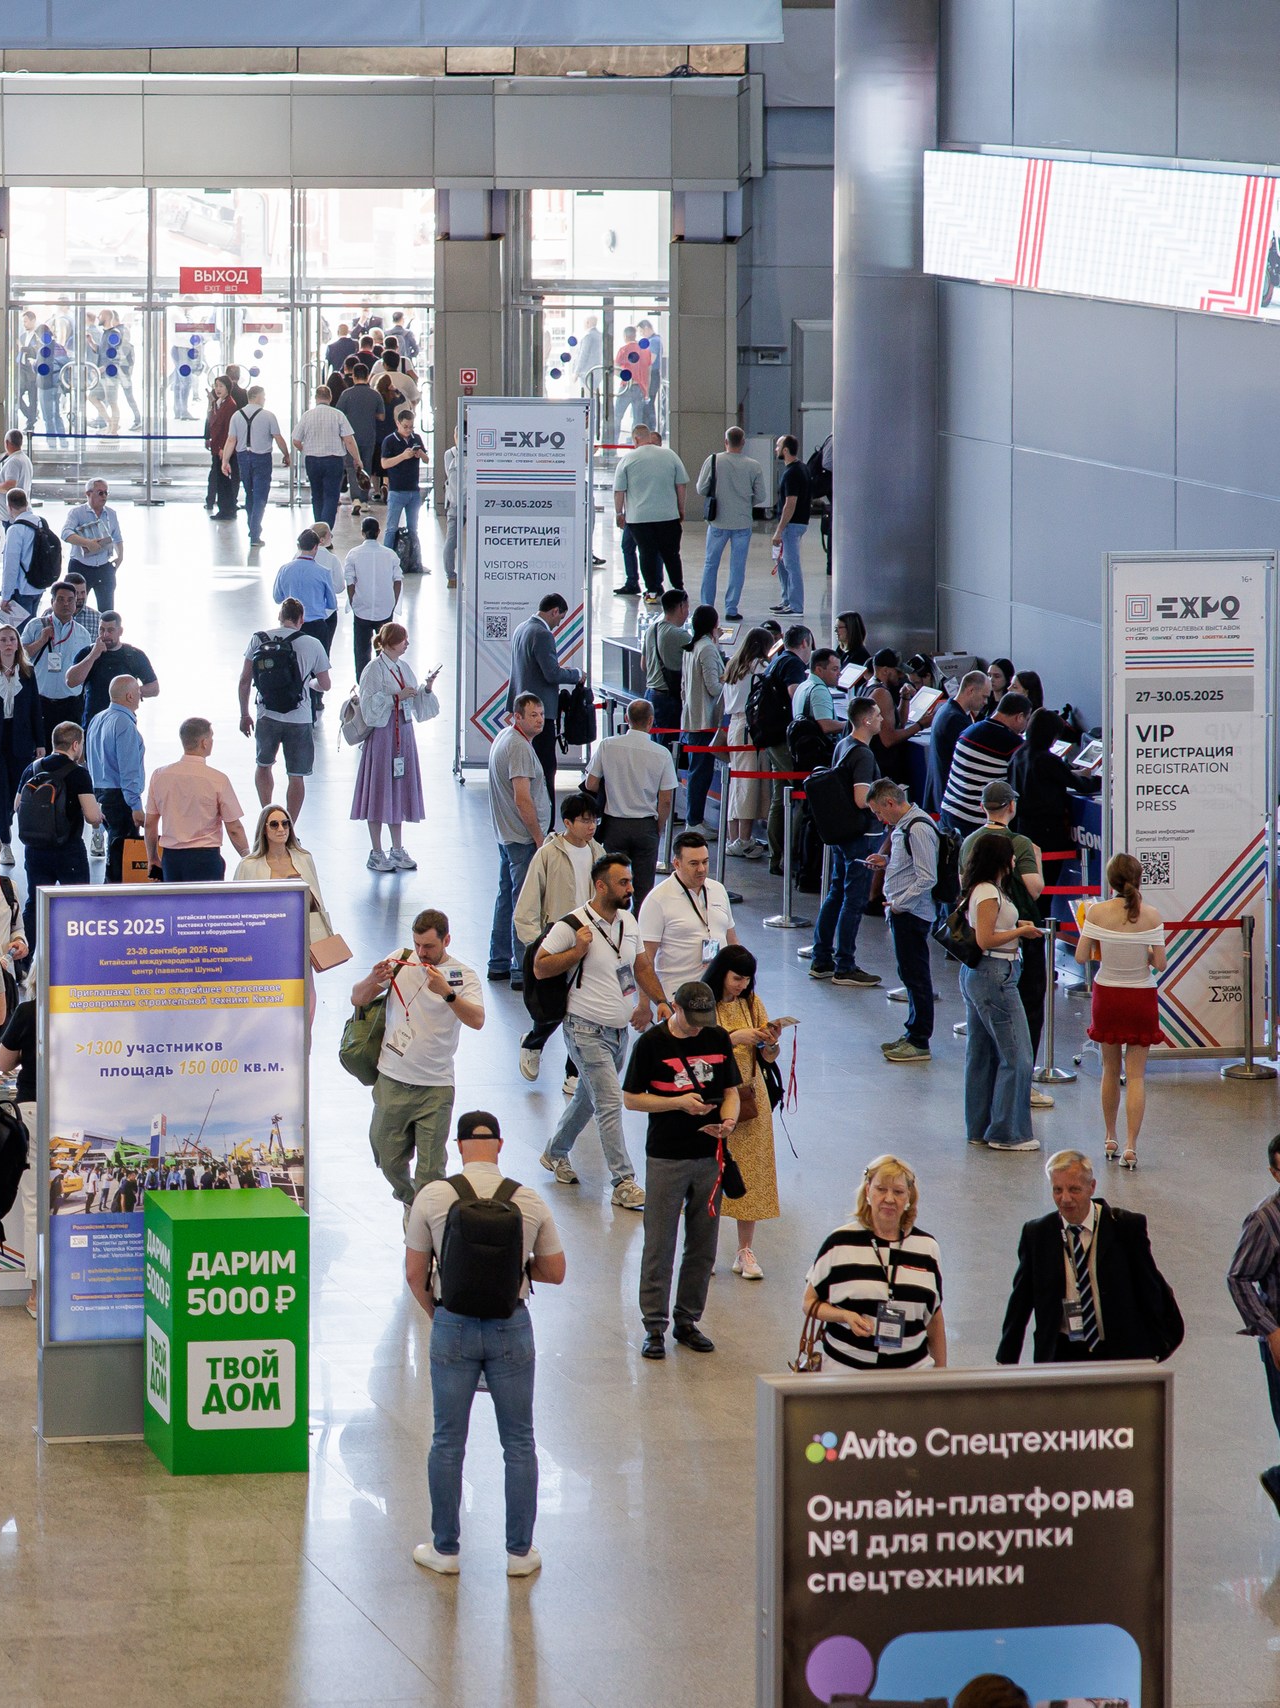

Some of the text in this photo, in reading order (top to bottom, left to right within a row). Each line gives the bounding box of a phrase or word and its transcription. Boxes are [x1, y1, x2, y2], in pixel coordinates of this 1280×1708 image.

[194, 270, 248, 284] ВЫХОД
[500, 431, 565, 449] EXPO
[484, 526, 560, 535] РЕГИСТРАЦИЯ
[484, 536, 560, 546] ПОСЕТИТЕЛЕЙ
[484, 561, 528, 569] VISITORS
[484, 572, 556, 580] REGISTRATION
[1156, 595, 1240, 620] EXPO
[1136, 724, 1174, 742] VIP
[1136, 746, 1234, 758] РЕГИСТРАЦИЯ
[1136, 762, 1229, 775] REGISTRATION
[1136, 785, 1190, 795] ПРЕССА
[1136, 800, 1177, 811] PRESS
[67, 919, 165, 936] BICES 2025
[126, 947, 148, 955] 23-26
[150, 946, 187, 955] сентября
[189, 946, 208, 954] 2025
[100, 955, 253, 967] Китайский международный выставочный
[155, 967, 193, 975] (павильон
[195, 966, 222, 974] Шуньи)
[70, 988, 131, 998] Приглашаем
[134, 987, 151, 996] Вас
[169, 985, 222, 996] старейшее
[225, 984, 281, 994] отраслевое
[70, 994, 284, 1010] мероприятие строительной техники Китая!
[75, 1040, 223, 1057] >1300 участников
[100, 1059, 285, 1078] площадь 150 000 кв.м.
[147, 1227, 170, 1272] ДАРИМ
[187, 1249, 296, 1281] ДАРИМ
[187, 1286, 270, 1316] 5000
[150, 1334, 167, 1372] ТВОЙ
[206, 1348, 279, 1380] ТВОЙ
[150, 1366, 167, 1405] ДОМ
[201, 1382, 281, 1415] ДОМ
[839, 1426, 1134, 1459] Avito Спецтехника
[807, 1487, 1134, 1522] Онлайн-платформа
[808, 1526, 1074, 1559] №1 для покупки
[807, 1563, 1024, 1594] спецтехники
